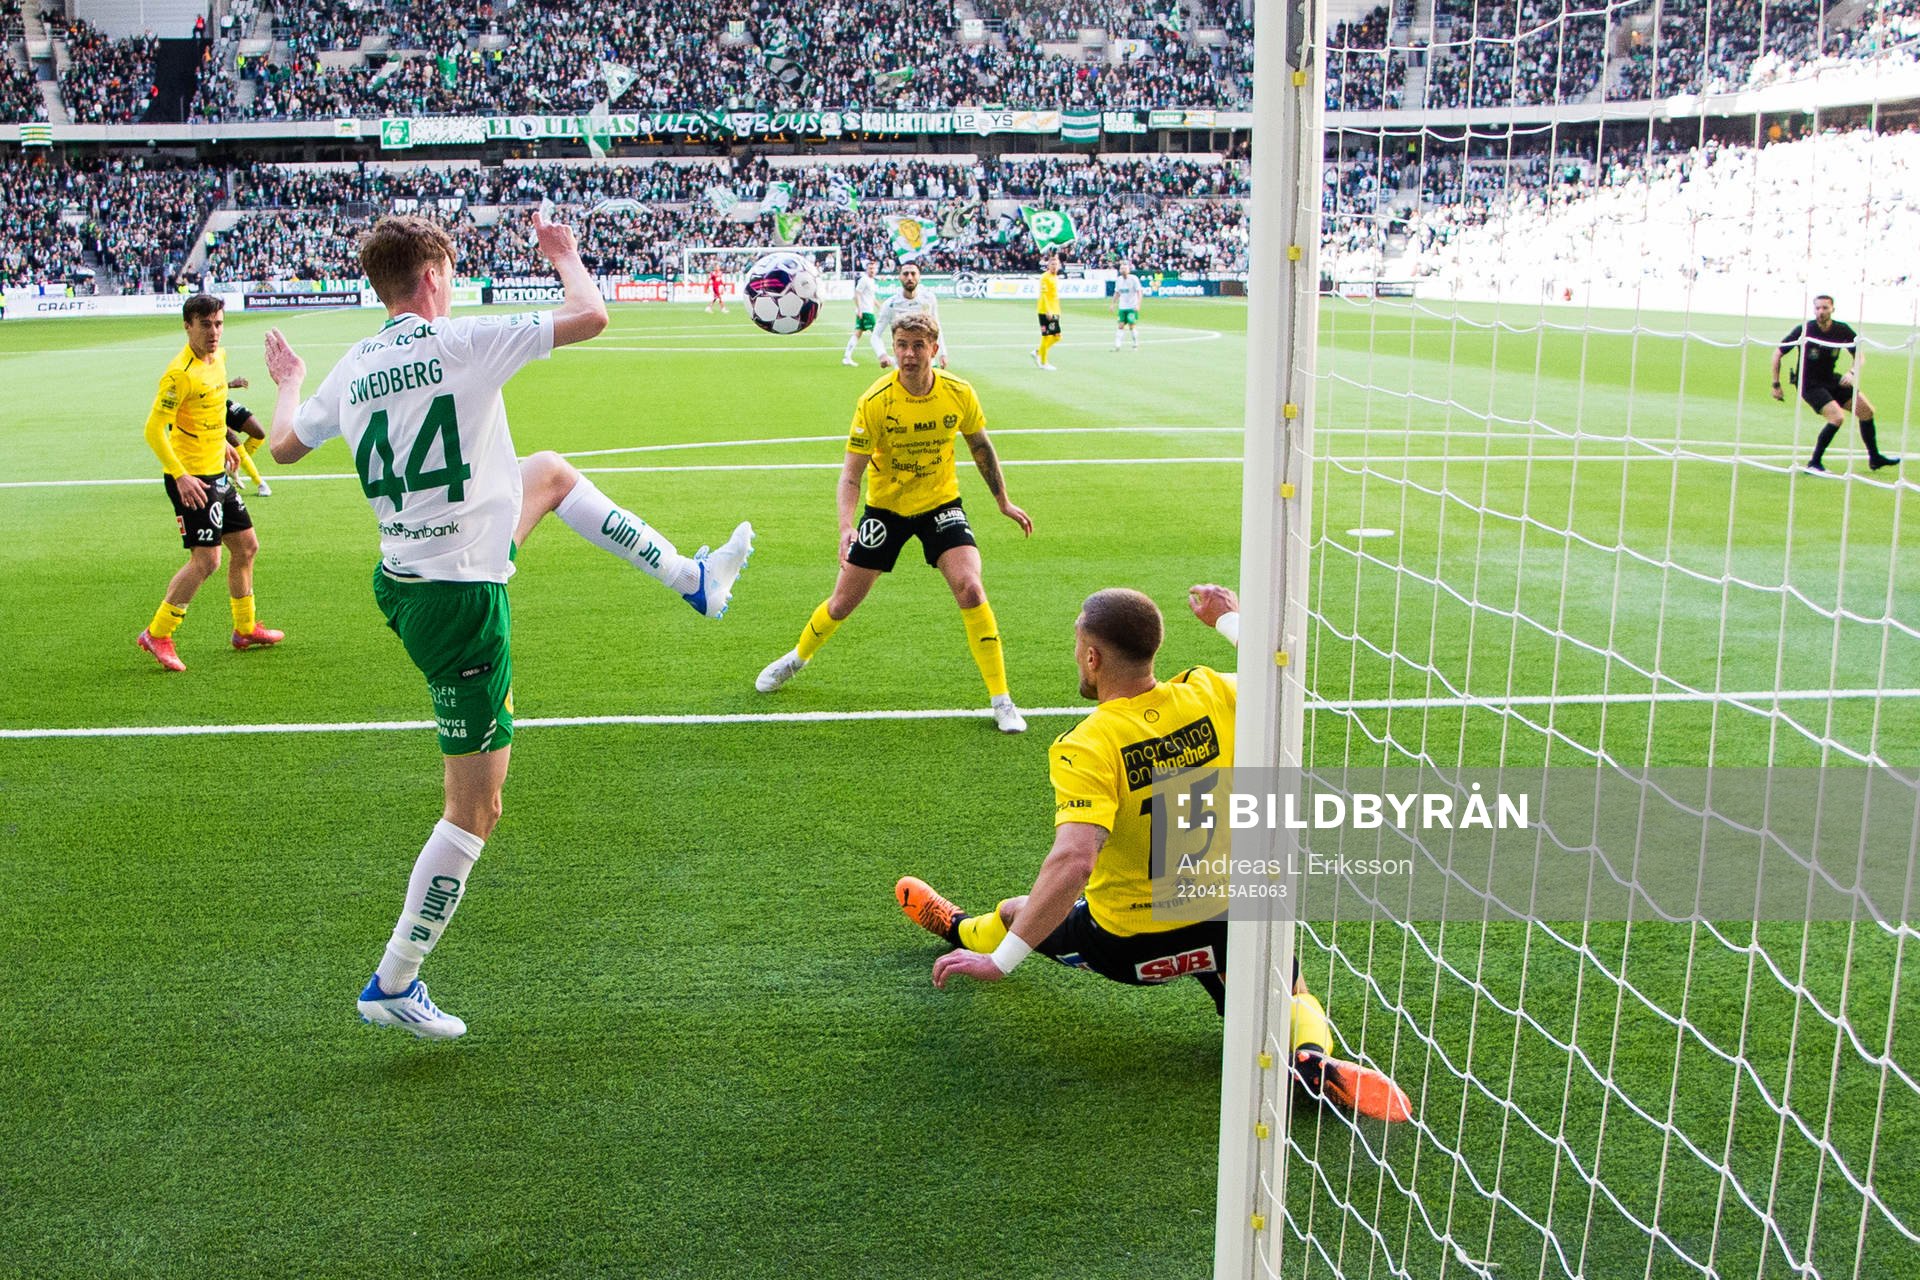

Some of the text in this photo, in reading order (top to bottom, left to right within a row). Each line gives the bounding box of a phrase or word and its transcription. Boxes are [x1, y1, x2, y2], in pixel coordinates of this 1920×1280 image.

[544, 115, 636, 134] ULTAS
[753, 112, 819, 134] BOYS
[37, 301, 84, 312] CRAFT
[350, 358, 443, 405] SWEDBERG
[355, 393, 471, 513] 44
[197, 529, 214, 541] 22
[451, 728, 468, 738] AB
[1124, 721, 1213, 768] marching
[1128, 740, 1210, 784] on together
[1139, 769, 1219, 879] 15
[409, 875, 461, 942] Clintn.
